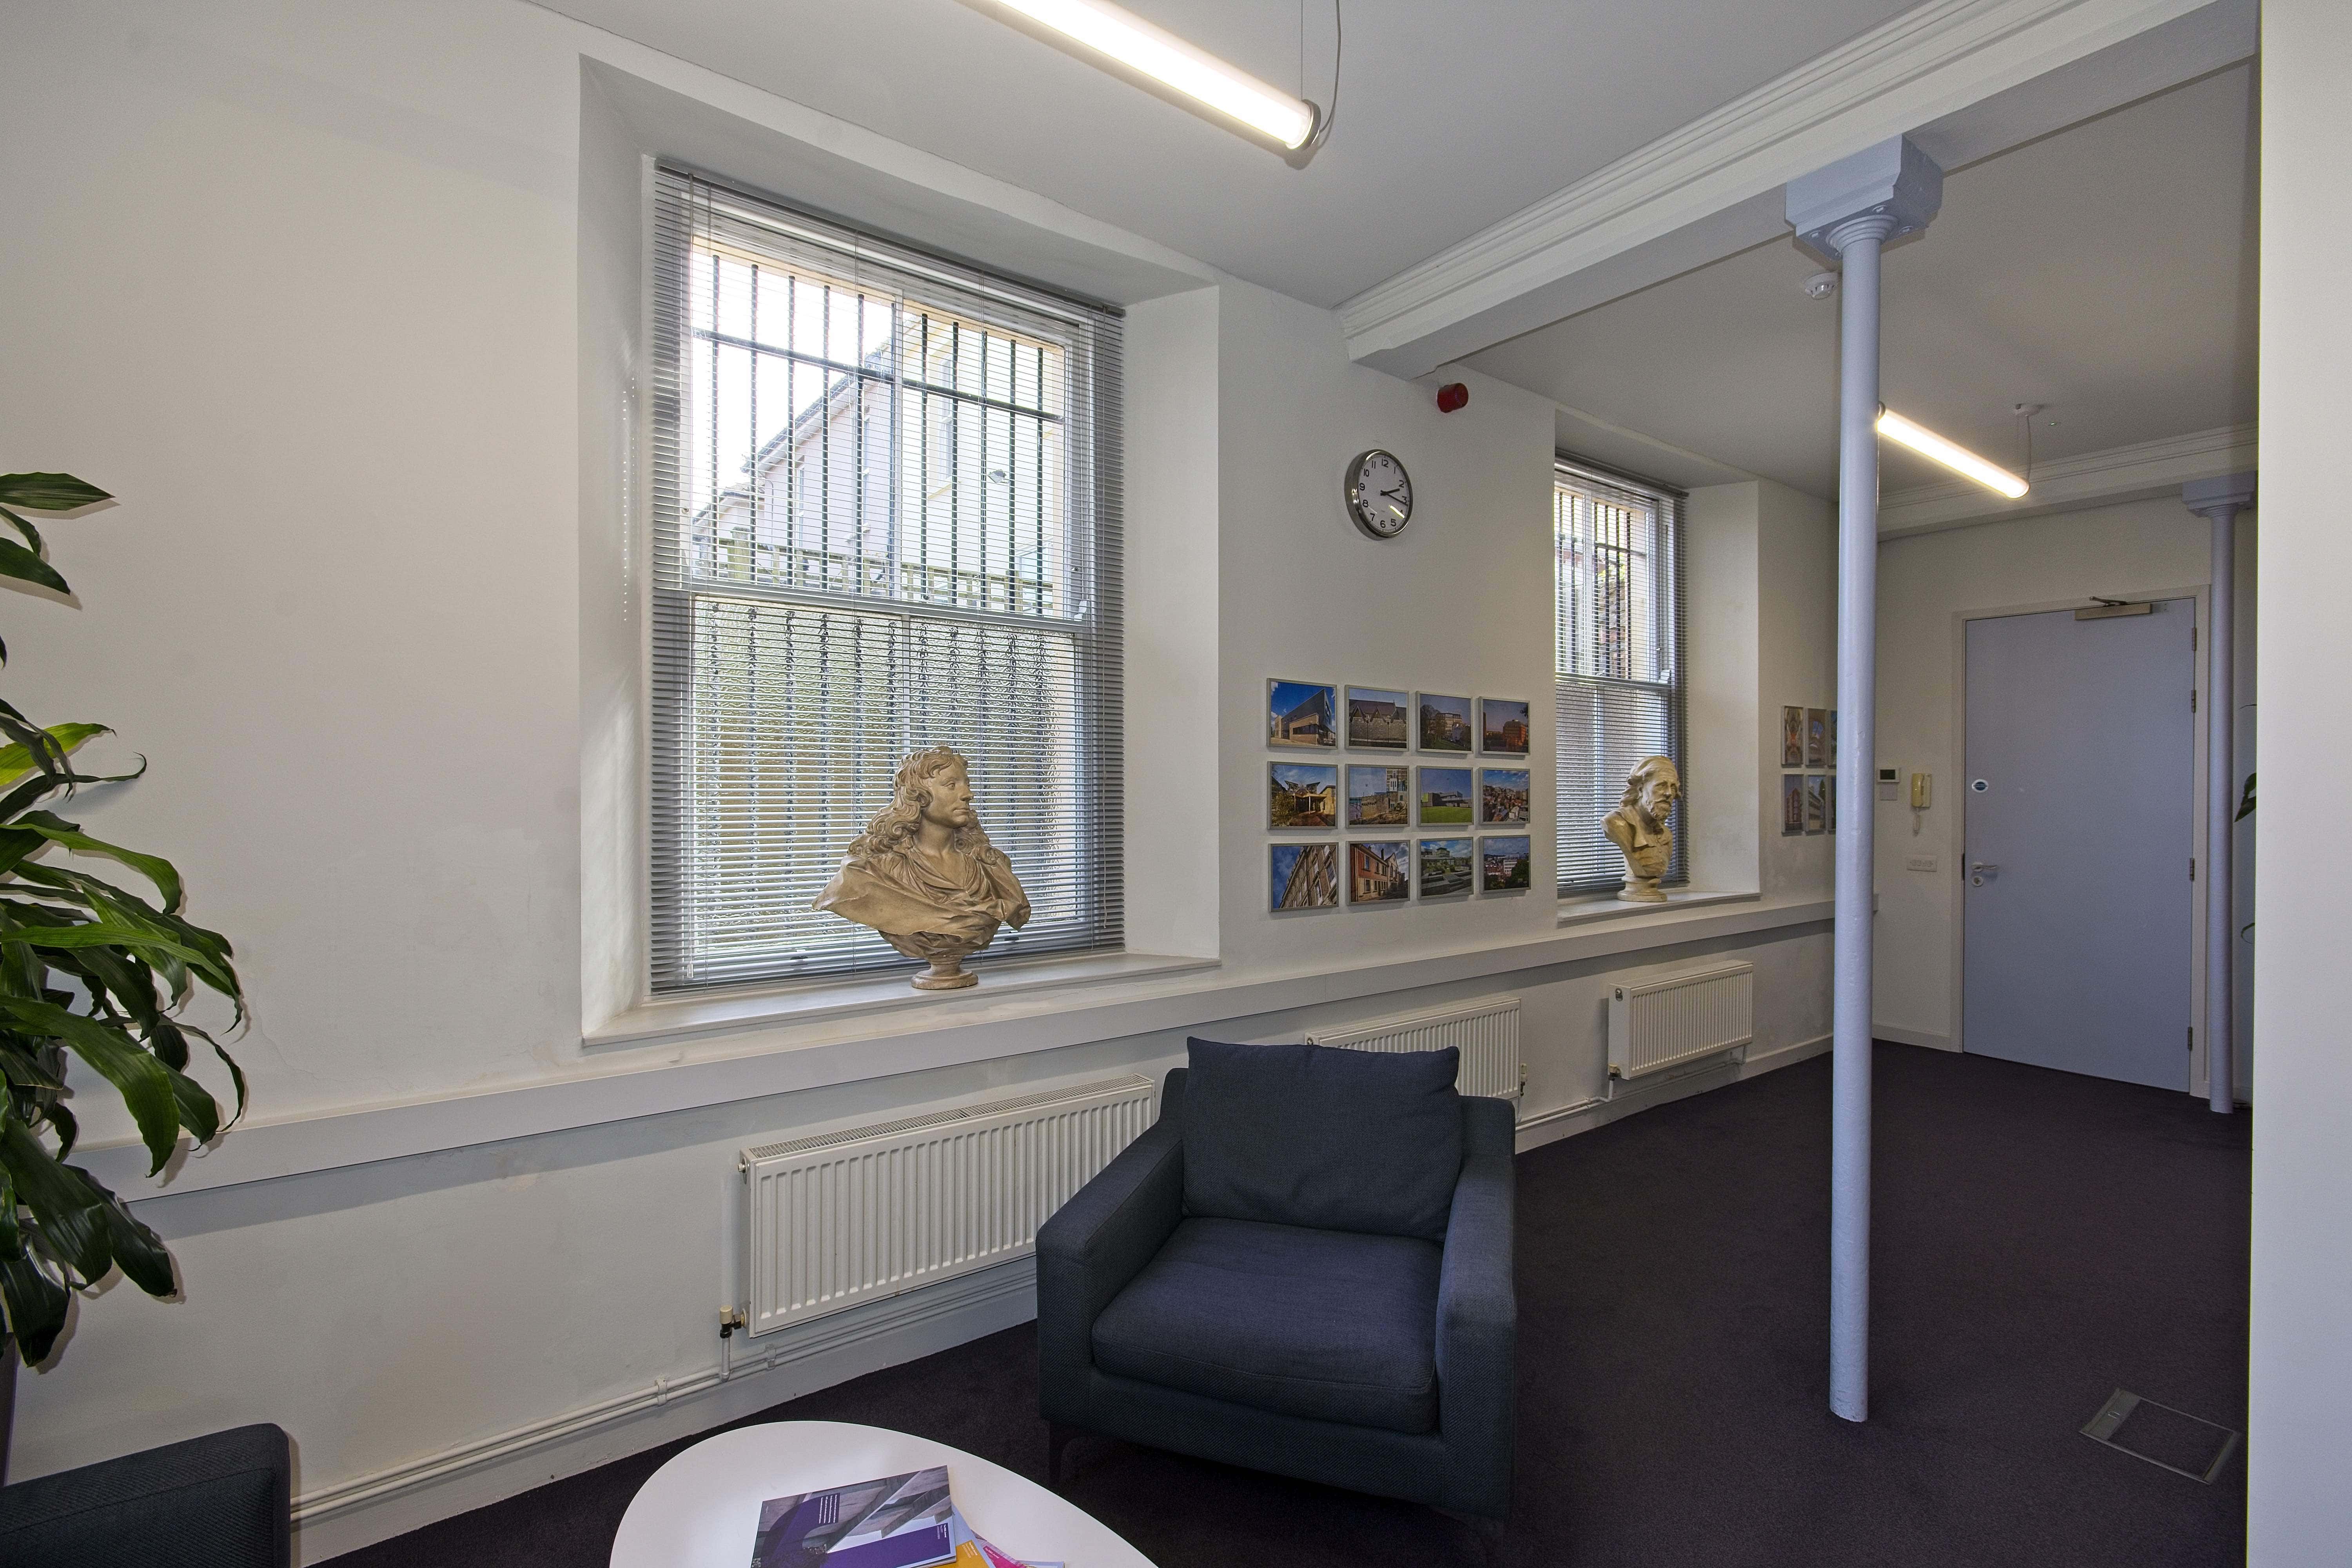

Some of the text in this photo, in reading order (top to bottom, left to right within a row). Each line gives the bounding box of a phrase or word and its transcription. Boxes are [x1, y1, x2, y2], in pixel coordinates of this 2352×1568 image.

[1372, 461, 1376, 469] 11
[1381, 458, 1389, 468] 12
[1363, 468, 1370, 477] 10
[1401, 495, 1407, 504] 3
[1370, 513, 1376, 521] 7
